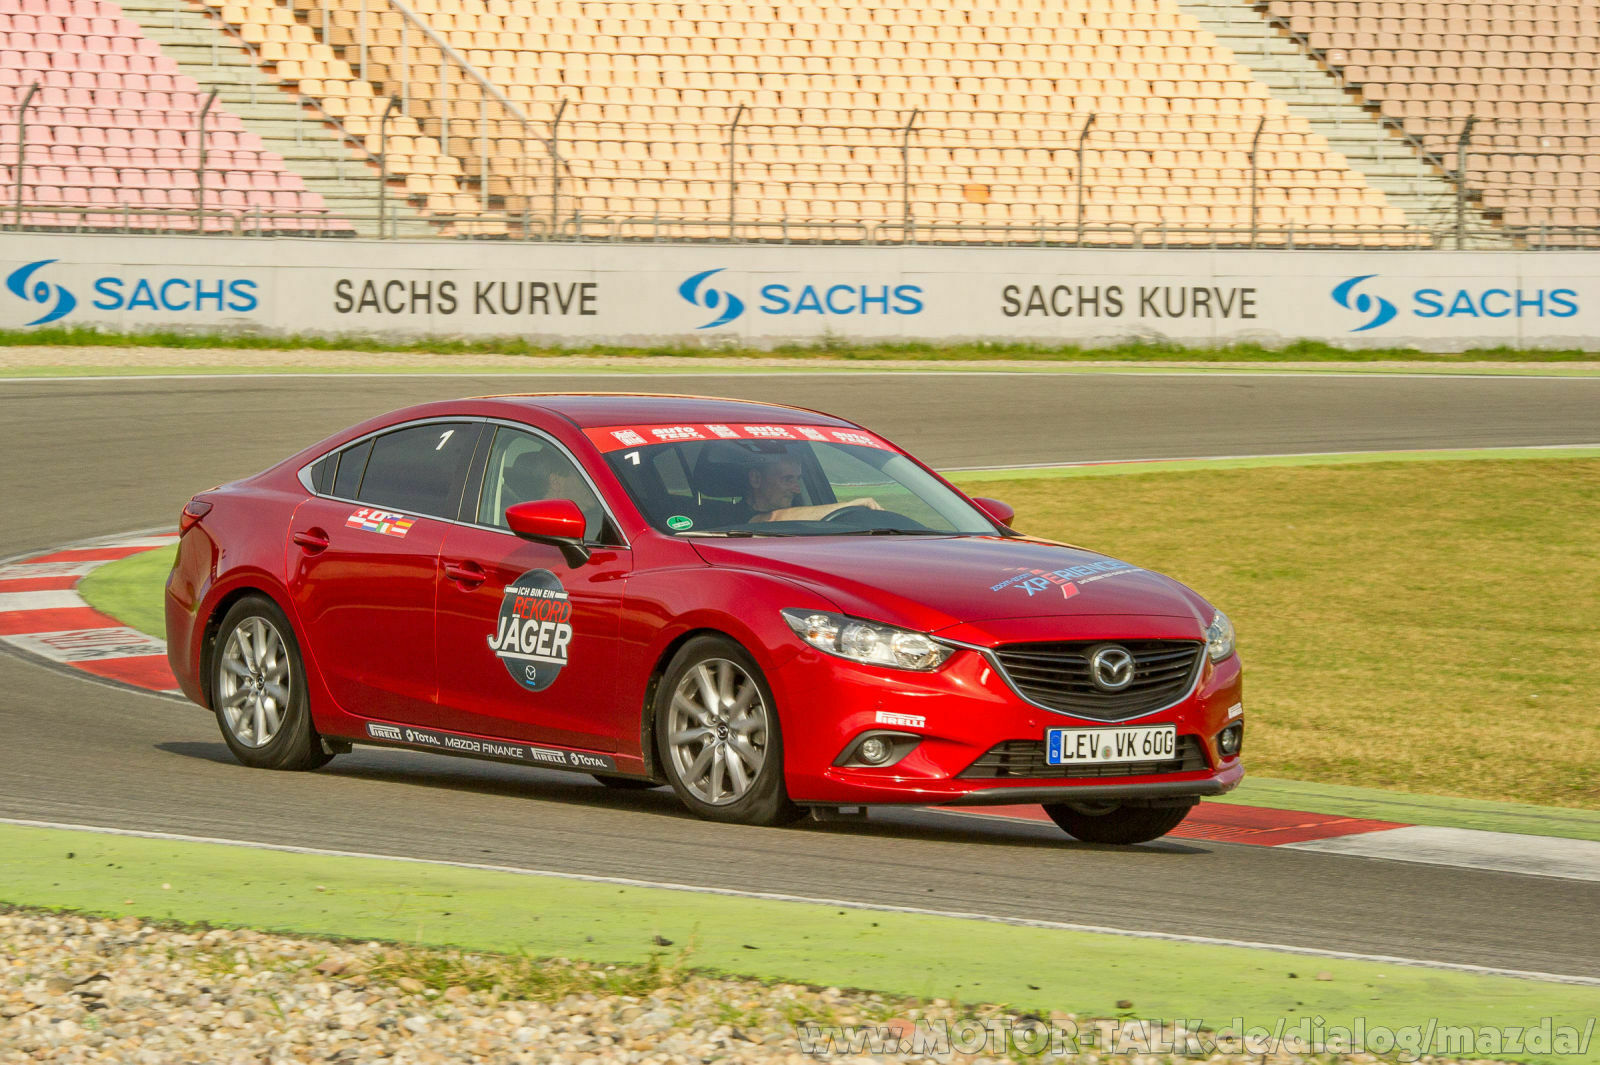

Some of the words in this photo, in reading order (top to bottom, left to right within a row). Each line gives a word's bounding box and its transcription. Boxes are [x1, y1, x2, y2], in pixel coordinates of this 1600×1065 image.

[93, 277, 258, 312] SACHS
[335, 279, 458, 316] SACHS
[474, 281, 599, 317] KURVE
[760, 284, 924, 316] SACHS
[1001, 285, 1125, 318] SACHS
[1139, 287, 1257, 319] KURVE
[1412, 288, 1580, 318] SACHS
[435, 429, 455, 451] 1
[624, 451, 641, 466] 1
[518, 586, 531, 596] ICH
[530, 588, 543, 598] BIN
[543, 590, 556, 599] EIN
[513, 596, 572, 623] REKORD
[487, 613, 573, 659] JÄGER
[368, 723, 403, 740] PIRELLI
[413, 731, 441, 745] TOTAL
[482, 743, 524, 758] FINANCE
[530, 747, 568, 764] PIRELLI
[577, 754, 608, 768] TOTAL
[1063, 733, 1100, 759] LEV
[1115, 732, 1138, 757] VK
